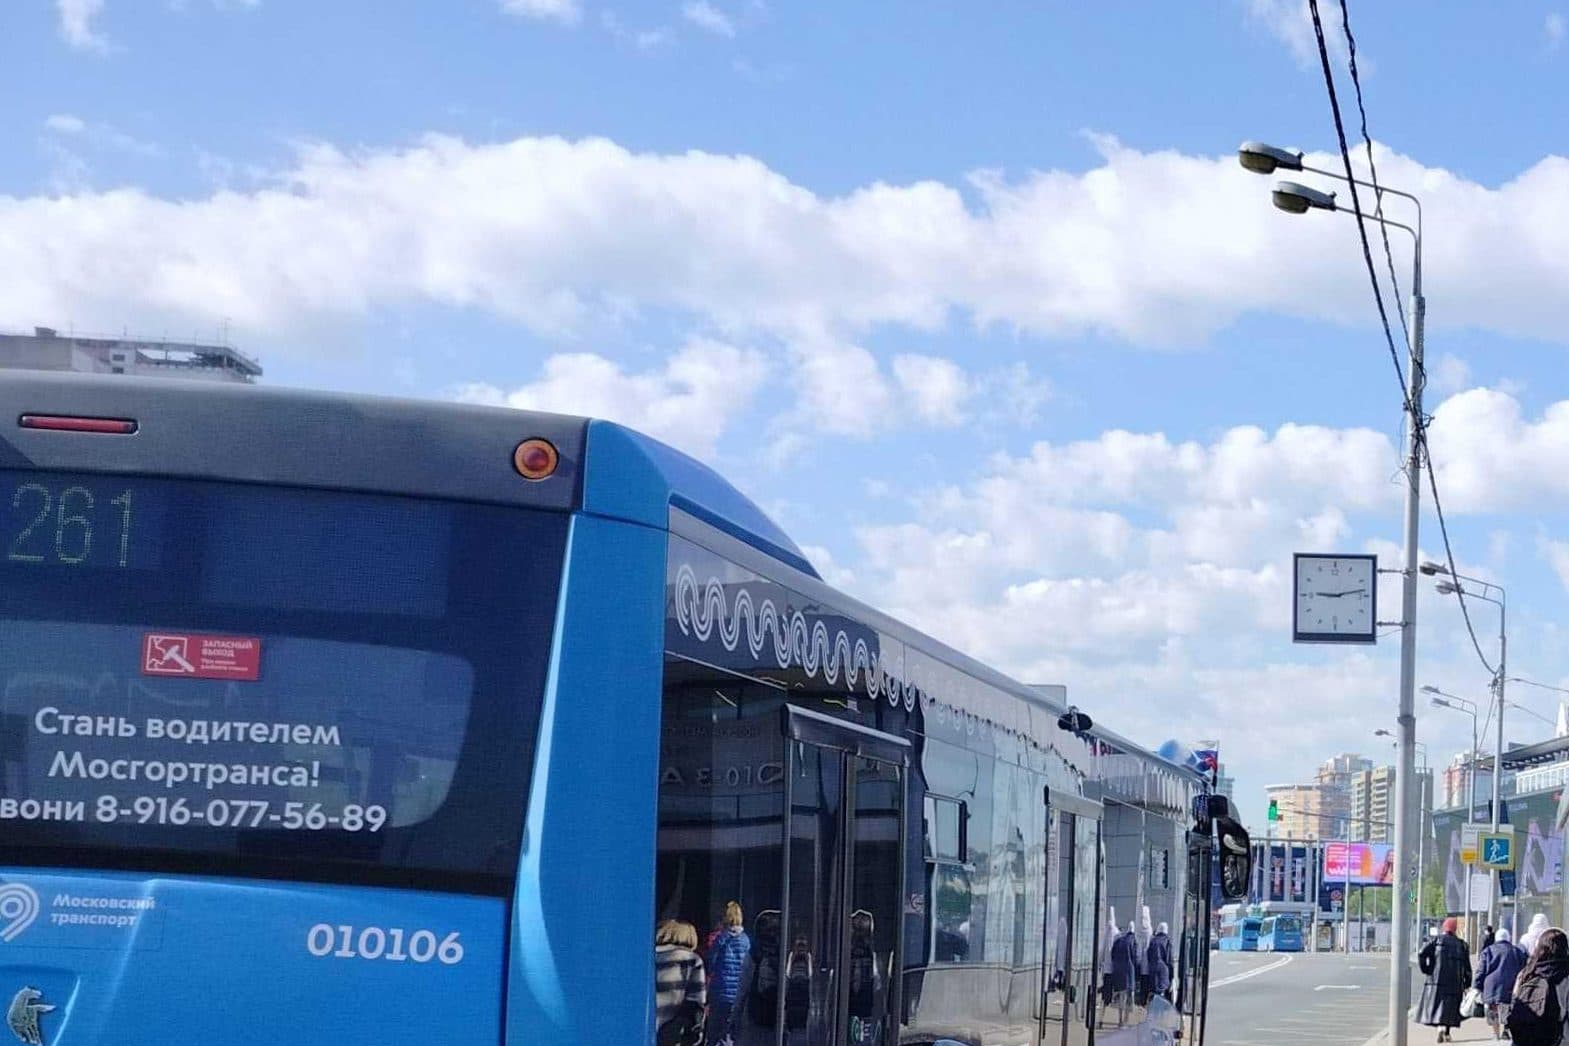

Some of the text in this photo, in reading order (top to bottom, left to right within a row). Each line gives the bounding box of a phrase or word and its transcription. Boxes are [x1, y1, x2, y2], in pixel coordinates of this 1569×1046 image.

[8, 481, 134, 567] 261
[35, 706, 340, 746] Стань водителем
[48, 751, 320, 790] Мосгортранса!
[0, 795, 387, 833] вони 8-916-077-56-89
[50, 911, 137, 927] транспорт
[52, 894, 156, 910] Московский
[307, 924, 464, 965] 010106
